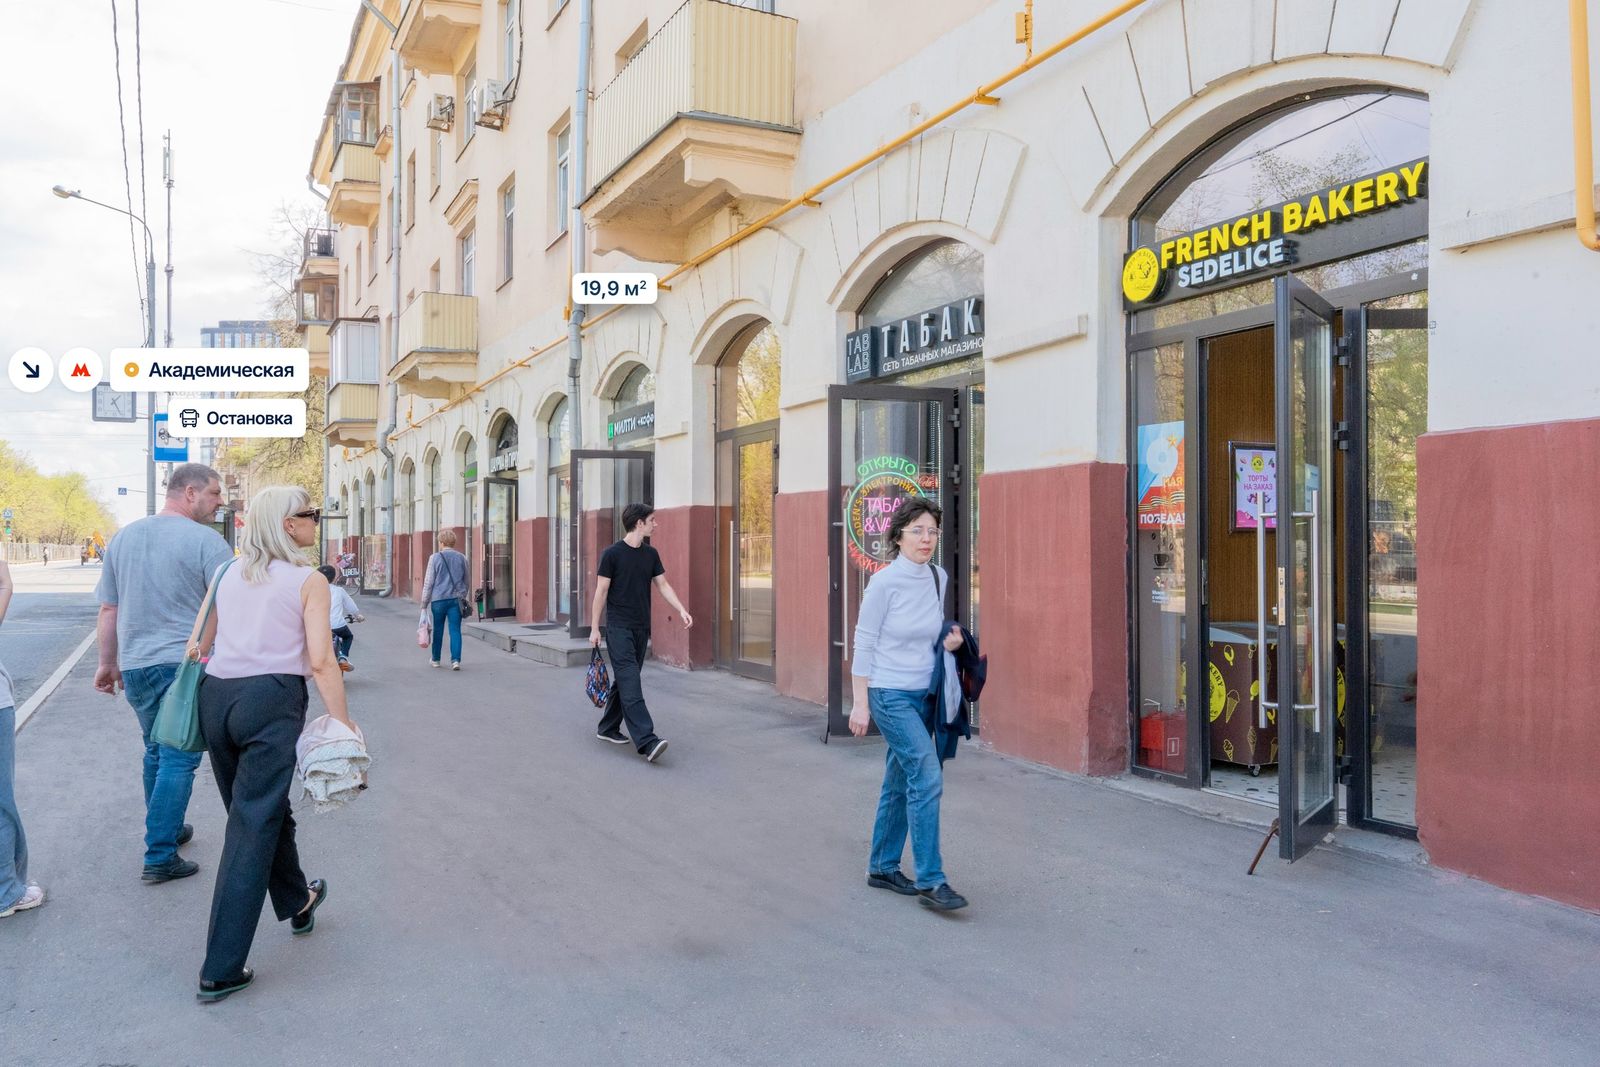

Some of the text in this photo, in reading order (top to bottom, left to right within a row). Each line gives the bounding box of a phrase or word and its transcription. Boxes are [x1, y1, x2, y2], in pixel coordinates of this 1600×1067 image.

[1160, 161, 1425, 269] FRENCH BAKERY
[1177, 238, 1284, 288] SEDELICE
[881, 298, 976, 358] ТАБАК
[847, 333, 870, 356] TAB
[882, 337, 985, 373] СЕТЬ ТАБАЧНЫХ МАГАЗИНО
[847, 351, 870, 374] LAB
[857, 456, 916, 477] ОТКРЫТО
[859, 476, 918, 497] ЭЛЕКТРОНКИ
[1243, 483, 1273, 491] НА ЗАКАЗ
[863, 497, 905, 513] ТАБА
